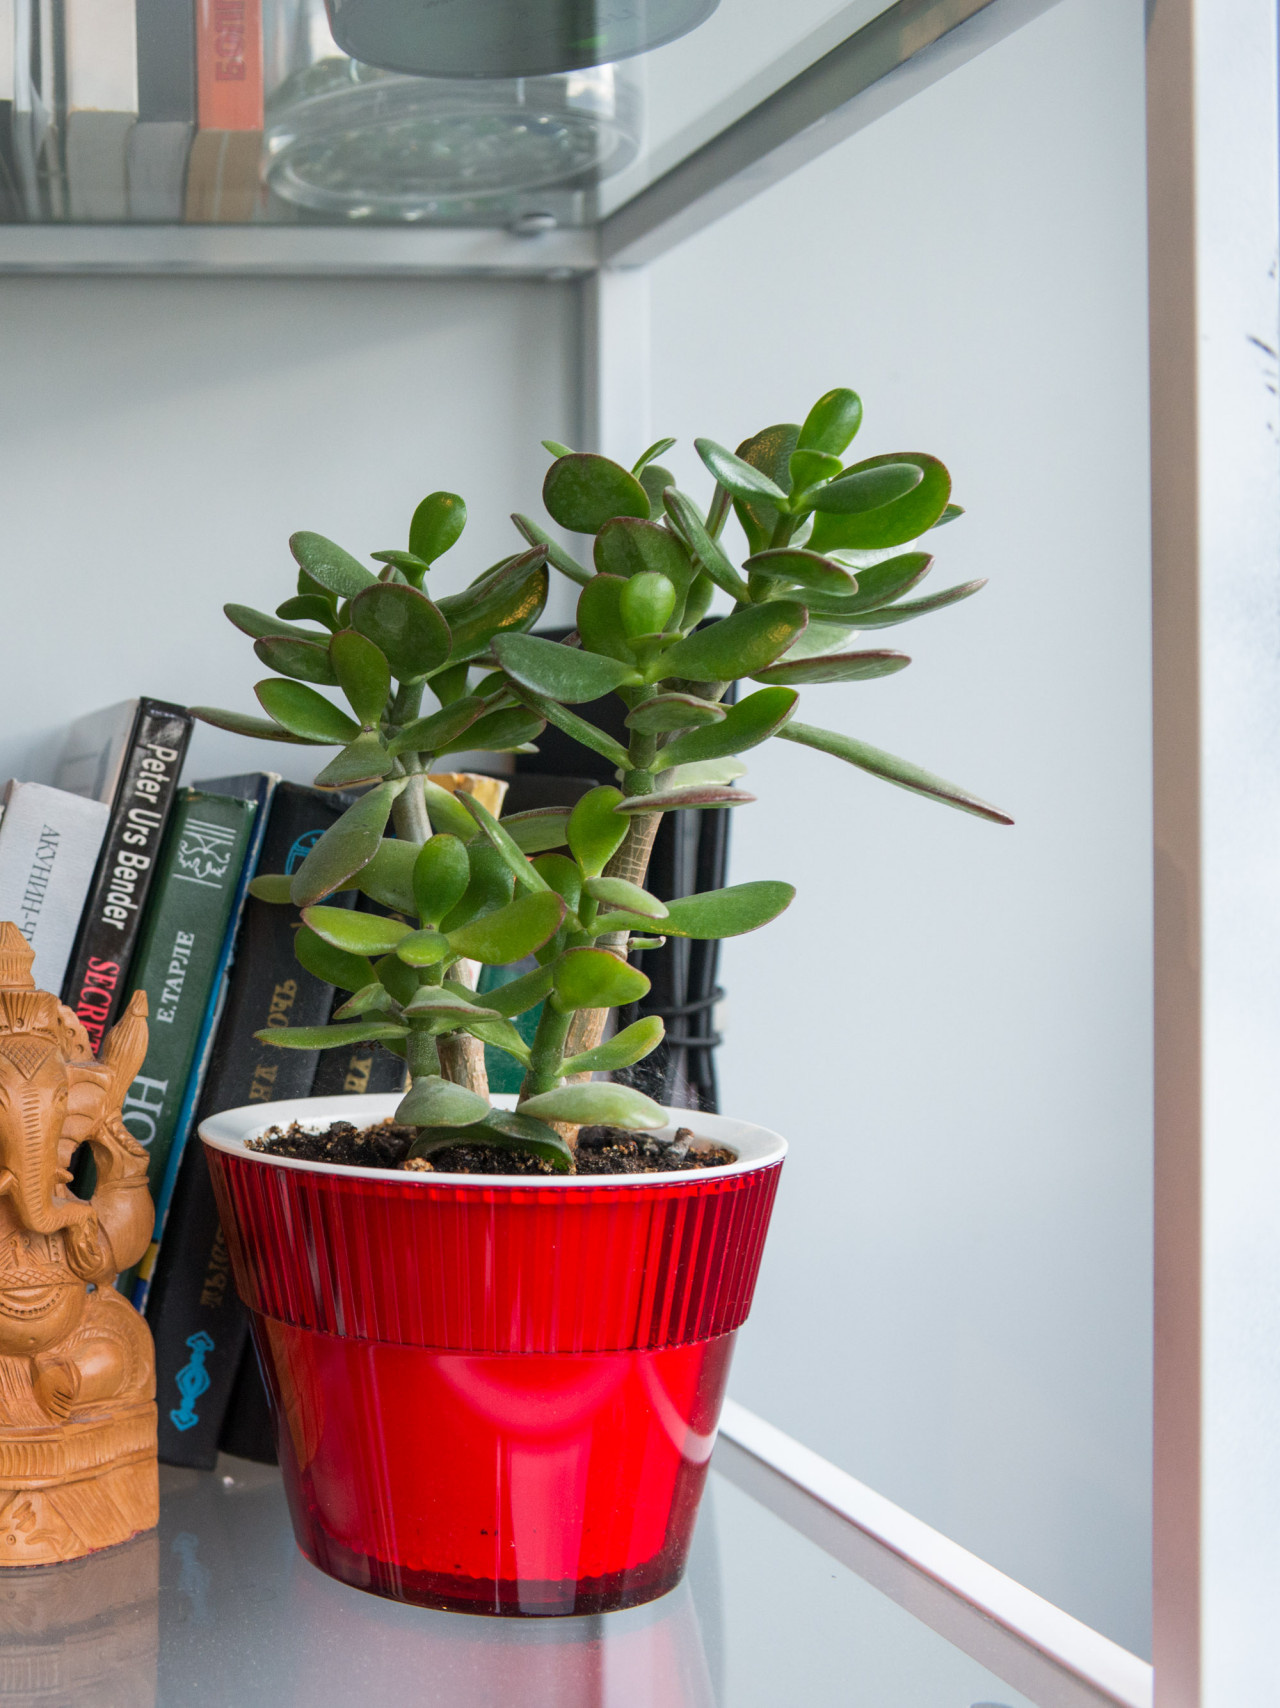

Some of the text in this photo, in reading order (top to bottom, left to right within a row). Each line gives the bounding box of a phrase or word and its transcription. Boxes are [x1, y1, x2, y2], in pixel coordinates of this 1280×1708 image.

[102, 743, 178, 931] Peter Urs Bender
[261, 979, 297, 1046] ОЧЬ
